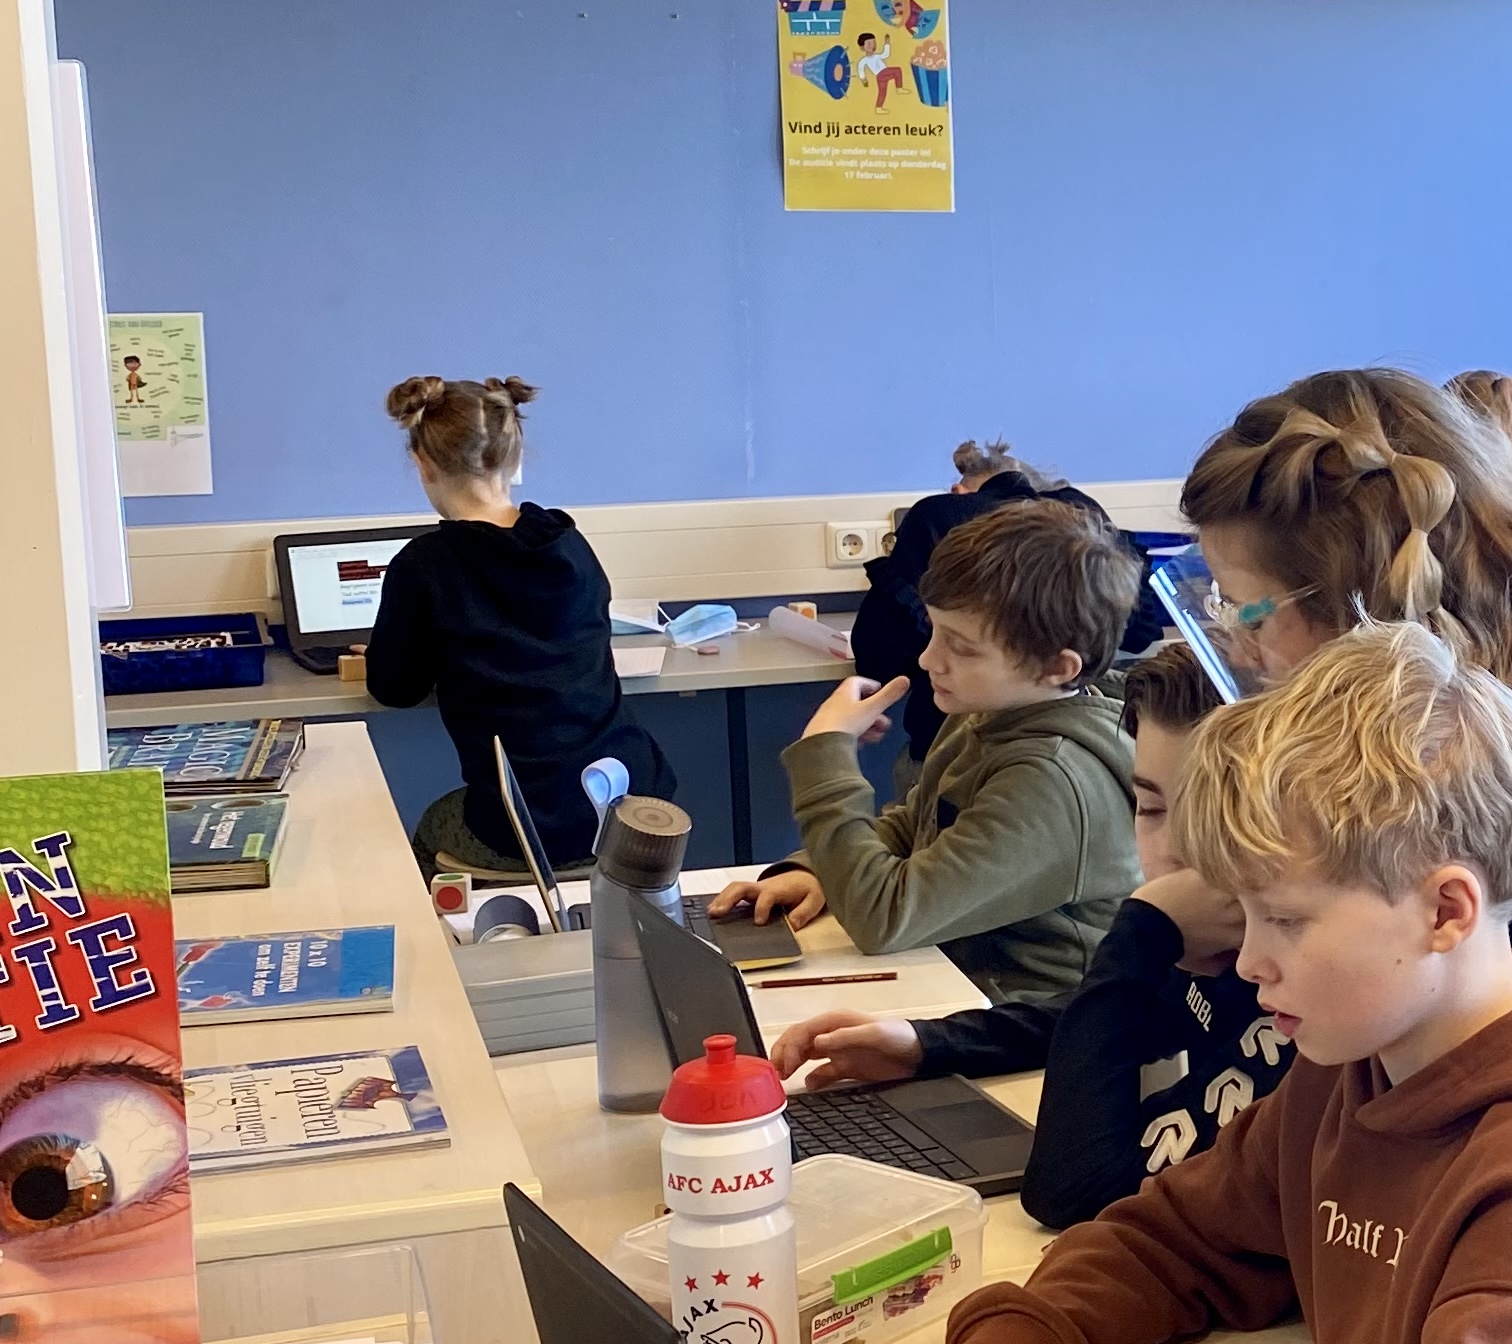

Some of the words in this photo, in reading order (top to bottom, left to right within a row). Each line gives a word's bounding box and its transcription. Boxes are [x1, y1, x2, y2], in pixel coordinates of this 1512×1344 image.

[788, 121, 822, 135] Vind
[826, 122, 840, 138] jij
[844, 123, 901, 136] acteren
[905, 123, 944, 137] leuk?
[802, 146, 831, 157] Schrijf
[831, 147, 841, 157] je
[841, 147, 867, 156] onder
[869, 148, 890, 156] deze
[891, 148, 919, 158] poster
[789, 158, 801, 167] De
[803, 159, 834, 167] auditie
[836, 160, 858, 168] vindt
[860, 160, 887, 169] plaats
[888, 161, 899, 170] op
[900, 160, 947, 170] donderdag
[180, 727, 250, 777] MAGIC
[257, 944, 272, 957] om
[308, 939, 328, 951] 10
[255, 956, 276, 970] zelf
[278, 941, 302, 994] EXPERIMENTEN
[307, 957, 328, 968] 10
[251, 979, 274, 997] doen
[216, 1072, 273, 1147] vliegtuigen
[275, 1064, 344, 1140] Papieren
[667, 1172, 703, 1194] AFC
[710, 1167, 775, 1195] AJAX
[814, 1309, 843, 1330] Bento
[844, 1296, 874, 1316] Lunch
